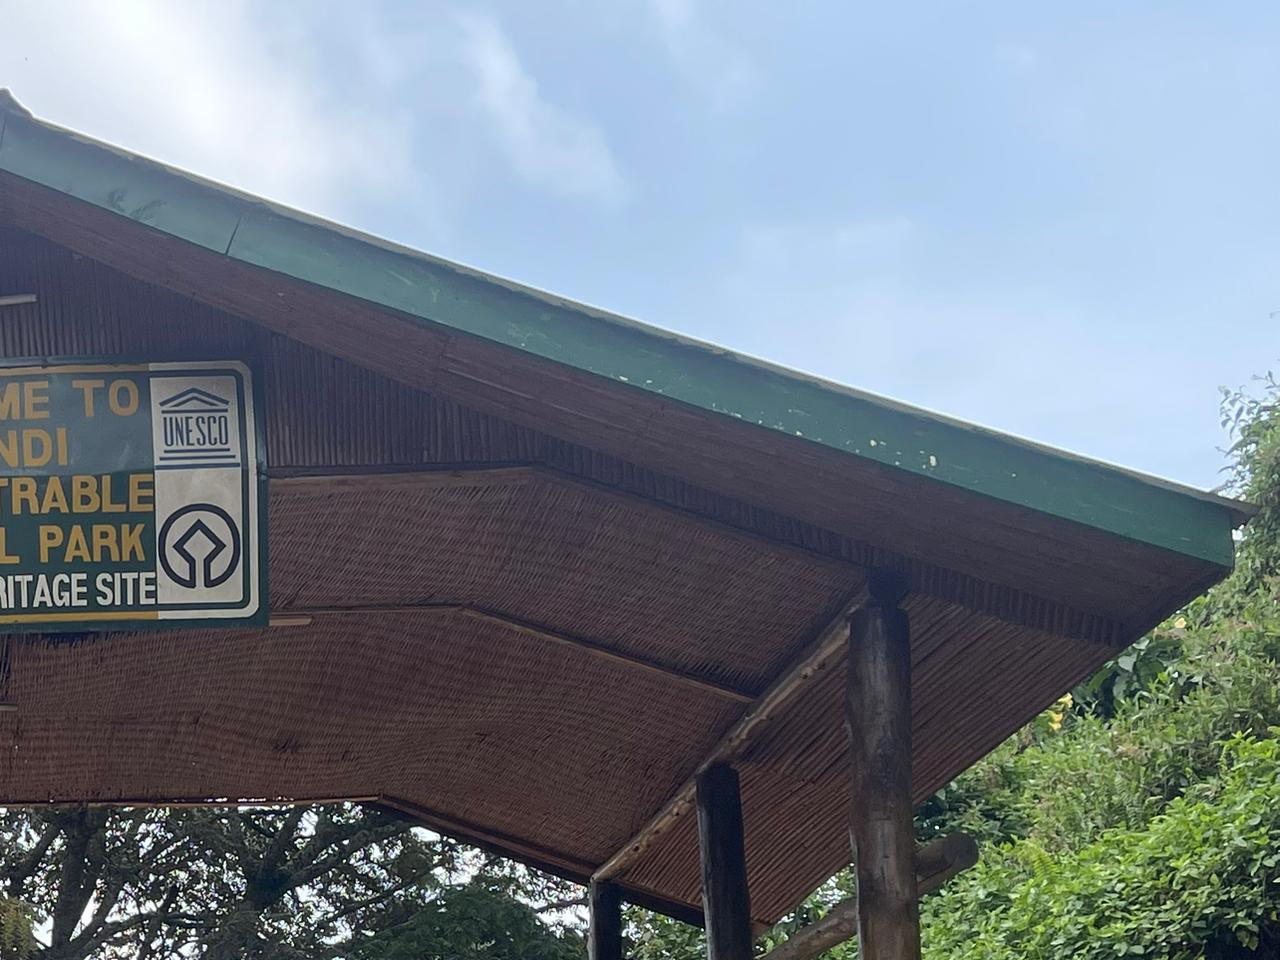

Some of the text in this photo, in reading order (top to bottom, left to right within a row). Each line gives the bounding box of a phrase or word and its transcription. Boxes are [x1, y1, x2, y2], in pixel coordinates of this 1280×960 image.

[72, 378, 139, 419] TO
[163, 414, 229, 449] UNESCO
[39, 522, 146, 565] PARK
[95, 570, 156, 608] SITE
